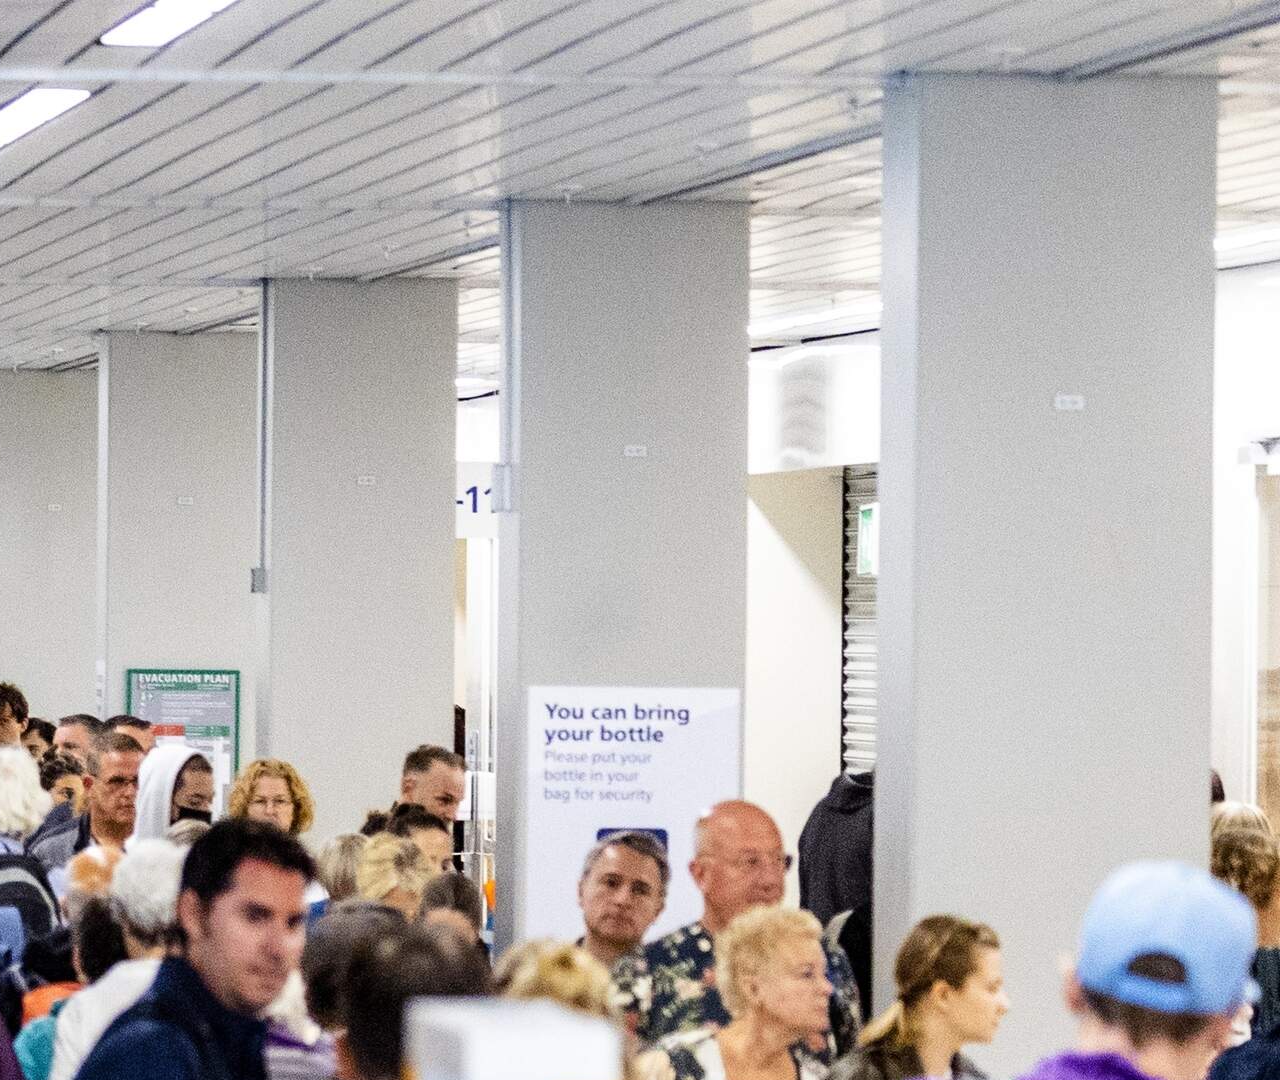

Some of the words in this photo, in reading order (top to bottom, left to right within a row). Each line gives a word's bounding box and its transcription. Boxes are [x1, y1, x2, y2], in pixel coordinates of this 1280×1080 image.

[139, 674, 202, 684] EVACUATION
[204, 674, 230, 684] PLAN
[545, 703, 584, 720] You
[591, 707, 627, 720] can
[634, 703, 690, 725] bring
[544, 728, 594, 745] your
[600, 725, 664, 742] bottle
[544, 750, 588, 763] Please
[592, 751, 617, 765] put
[621, 753, 652, 766] your
[544, 769, 587, 781] bottle
[591, 770, 603, 781] in
[608, 771, 640, 784] your
[544, 787, 570, 803] bag
[575, 787, 594, 800] for
[598, 788, 654, 803] security
